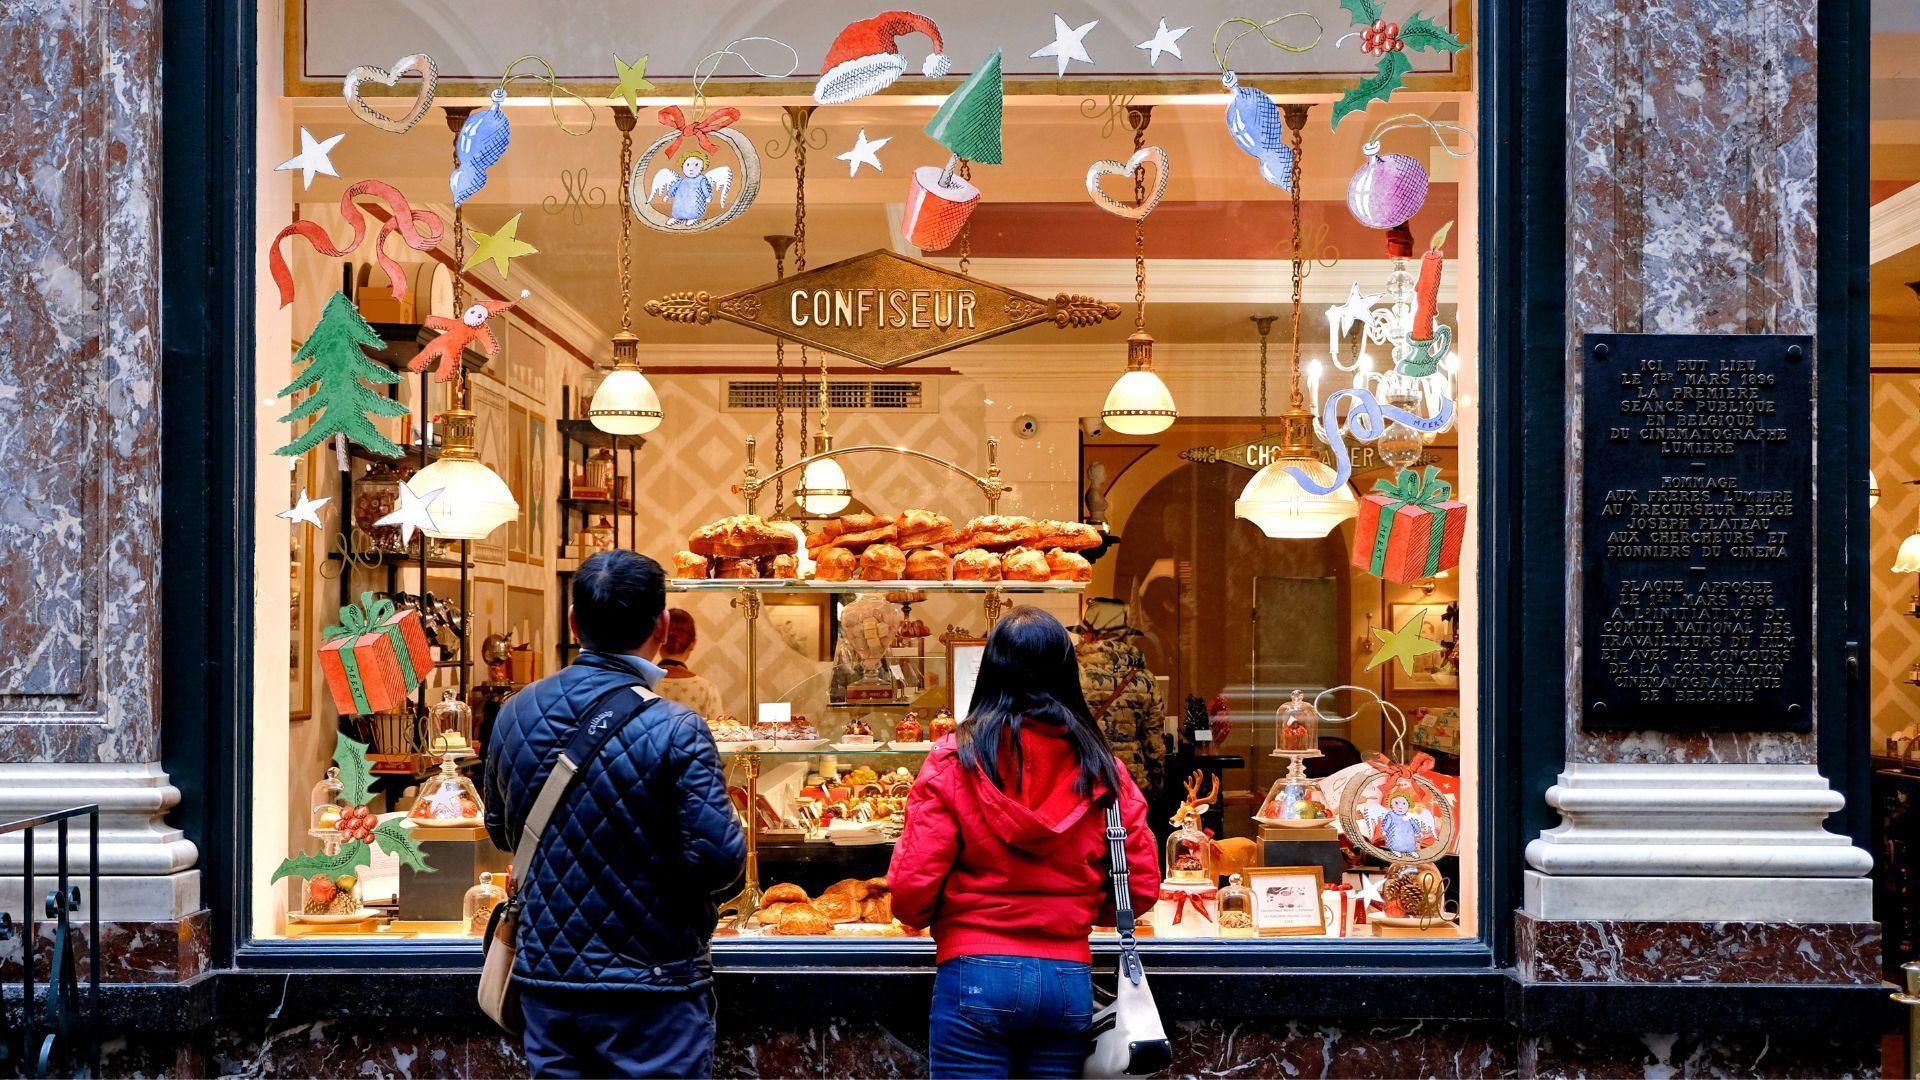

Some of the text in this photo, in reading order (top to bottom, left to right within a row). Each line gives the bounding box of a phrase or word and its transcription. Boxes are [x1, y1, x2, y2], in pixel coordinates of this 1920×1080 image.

[790, 288, 977, 329] CONFISEUR
[1640, 359, 1757, 373] ICI EUT LIEU
[1621, 373, 1776, 386] LE 1ER MARS 1896
[1637, 387, 1760, 400] LA PREMIERE
[1619, 400, 1777, 414] SEANCE PUBLIQUE
[1646, 415, 1756, 428] EN BELGIQUE
[1609, 428, 1788, 441] DU CINEMATOGRAPHE
[1661, 441, 1735, 454] LUMIERE
[1660, 476, 1739, 489] HOMMAGE
[1604, 490, 1793, 503] AUX FRERES LUMIERE
[1599, 504, 1794, 516] AU PRECURSEUR BELGE
[1626, 517, 1770, 530] JOSEPH PLATEAU
[1606, 531, 1789, 544] AUX CHERCHEURS ET
[1607, 545, 1789, 558] PIONNIERS DU CINEMA
[1620, 580, 1774, 593] PLAQUE APPOSEE
[1619, 594, 1775, 606] LE 1ER MARS 1956
[1610, 607, 1786, 620] A L'INITIATIVE DU
[1603, 621, 1792, 634] COMITE NATIONAL DES
[1599, 635, 1796, 648] TRAVAILLEURS DU FILM
[1600, 649, 1791, 661] ET AVEC LE CONCOURS
[1608, 662, 1785, 675] DE LA CORPORATION
[346, 665, 364, 699] MEERT
[1614, 676, 1781, 689] CINEMATOGRAPHIQUE
[1640, 690, 1755, 702] DE BELGIQUE
